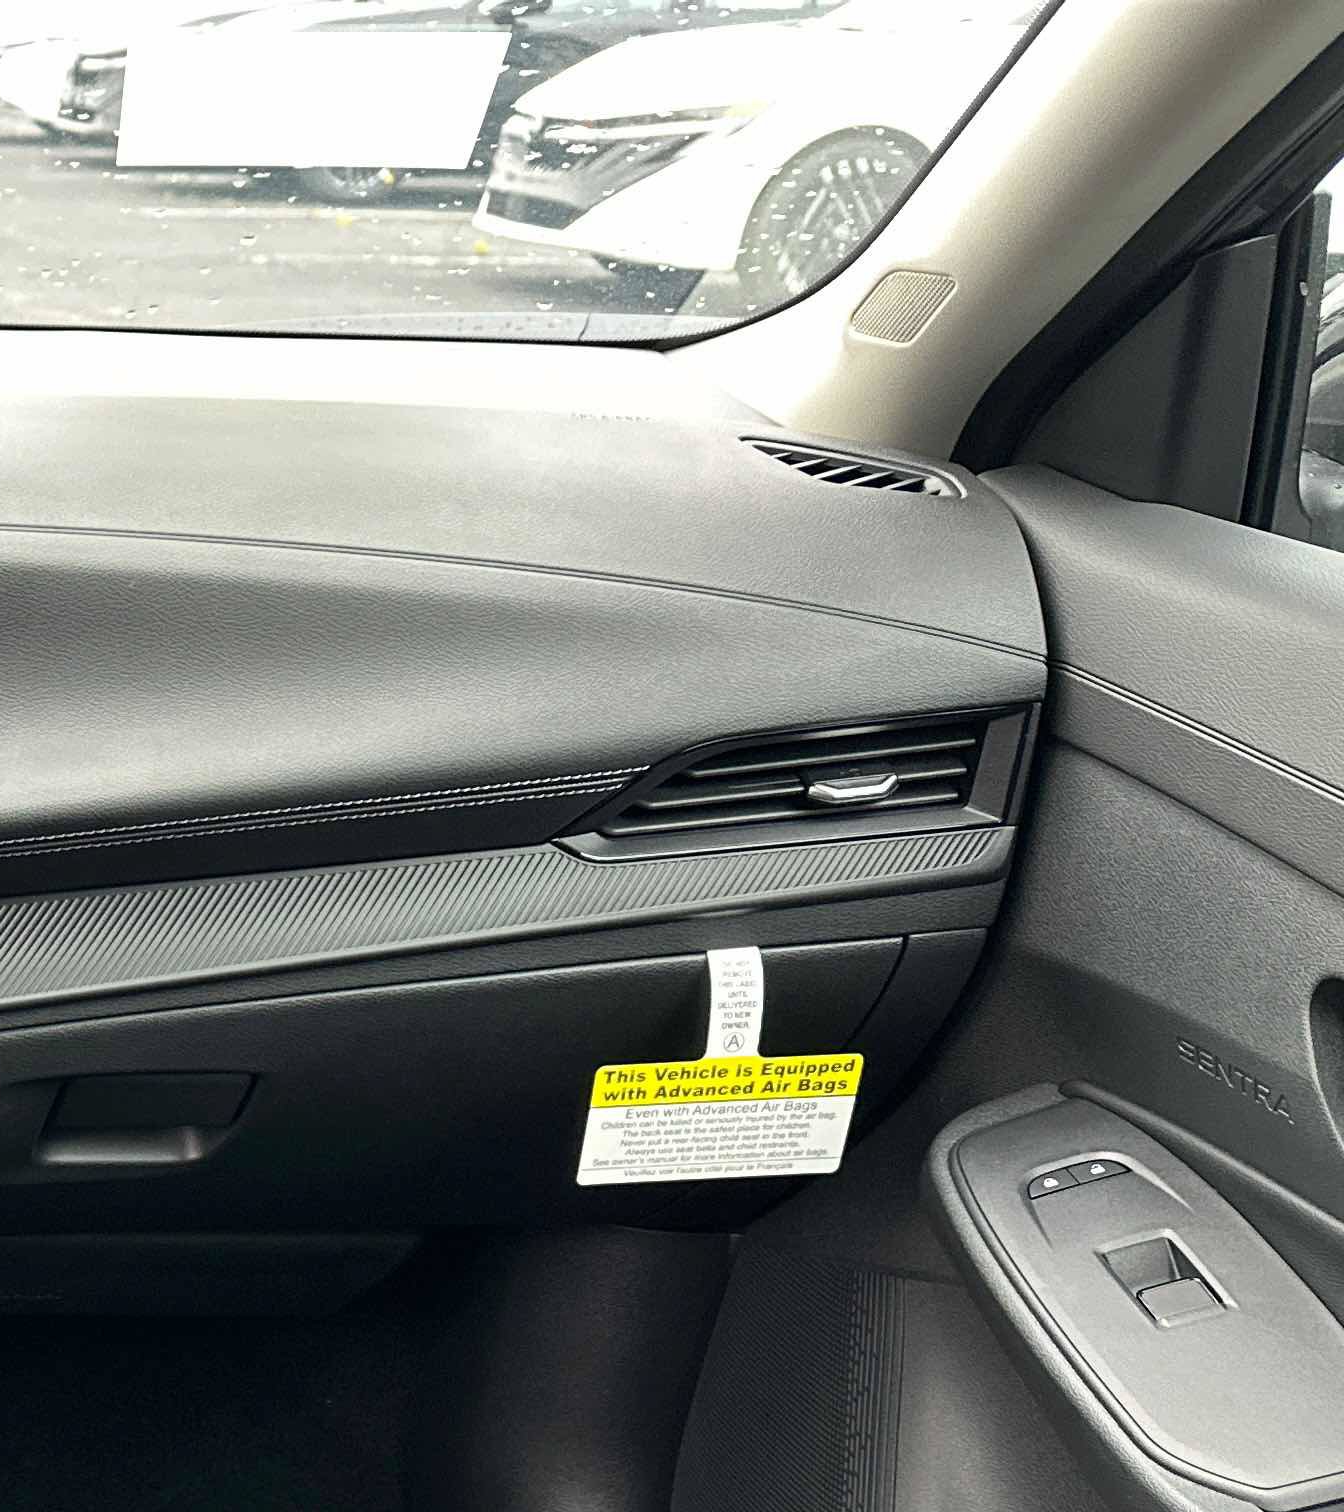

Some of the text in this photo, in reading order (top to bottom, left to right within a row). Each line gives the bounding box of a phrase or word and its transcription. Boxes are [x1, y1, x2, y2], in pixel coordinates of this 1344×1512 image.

[603, 1070, 647, 1084] This
[655, 1065, 729, 1081] Vehicle
[761, 1059, 856, 1077] Equipped
[1176, 1036, 1296, 1126] SENTRA
[603, 1079, 848, 1102] with Advanced Air Bags
[625, 1100, 818, 1119] Even with Advanced Air Bags
